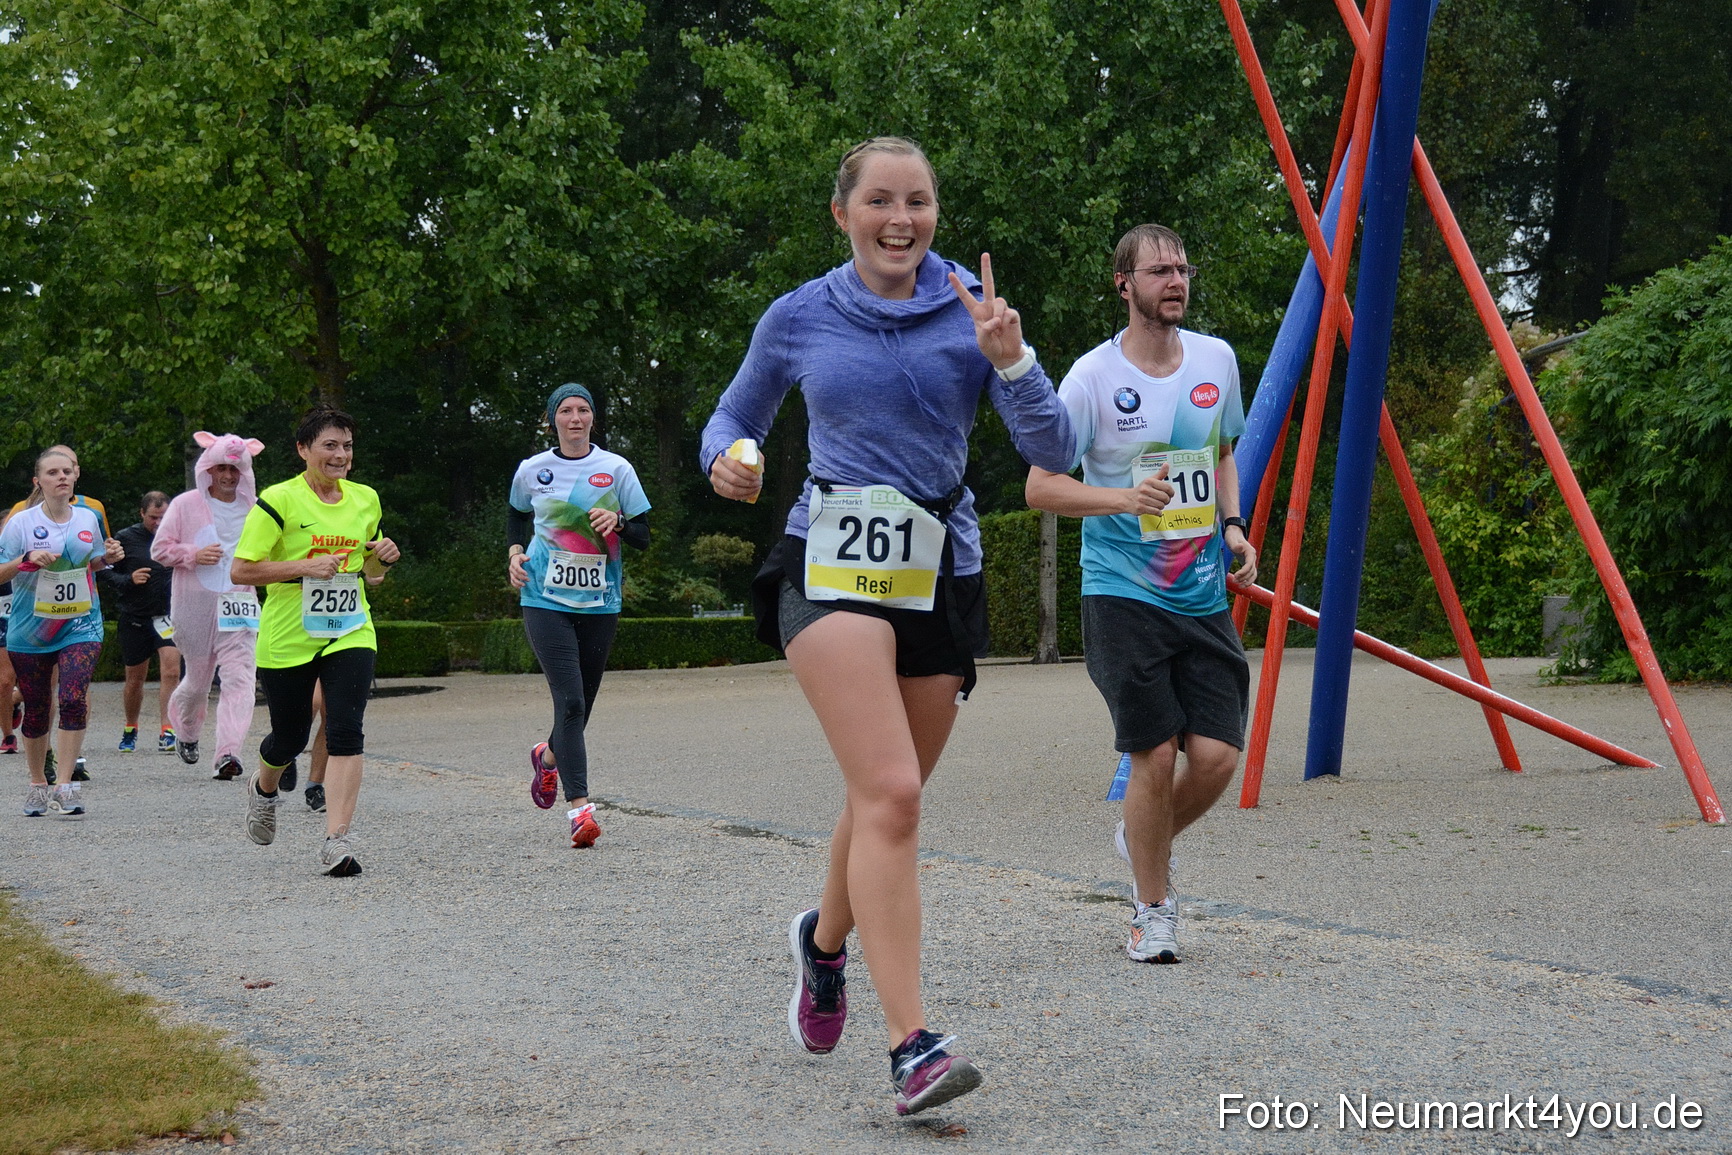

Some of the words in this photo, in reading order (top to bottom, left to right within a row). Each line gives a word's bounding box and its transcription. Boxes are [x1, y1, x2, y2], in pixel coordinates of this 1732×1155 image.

[1193, 389, 1217, 402] Hervis
[1117, 416, 1147, 427] PARTL
[1118, 424, 1148, 432] Neumarkt
[1164, 470, 1209, 503] 10
[311, 535, 359, 547] Müller
[837, 516, 913, 562] 261
[552, 564, 601, 587] 3008
[54, 583, 76, 601] 30
[856, 576, 893, 594] Resi
[51, 605, 77, 613] Sandra
[311, 589, 358, 613] 2528
